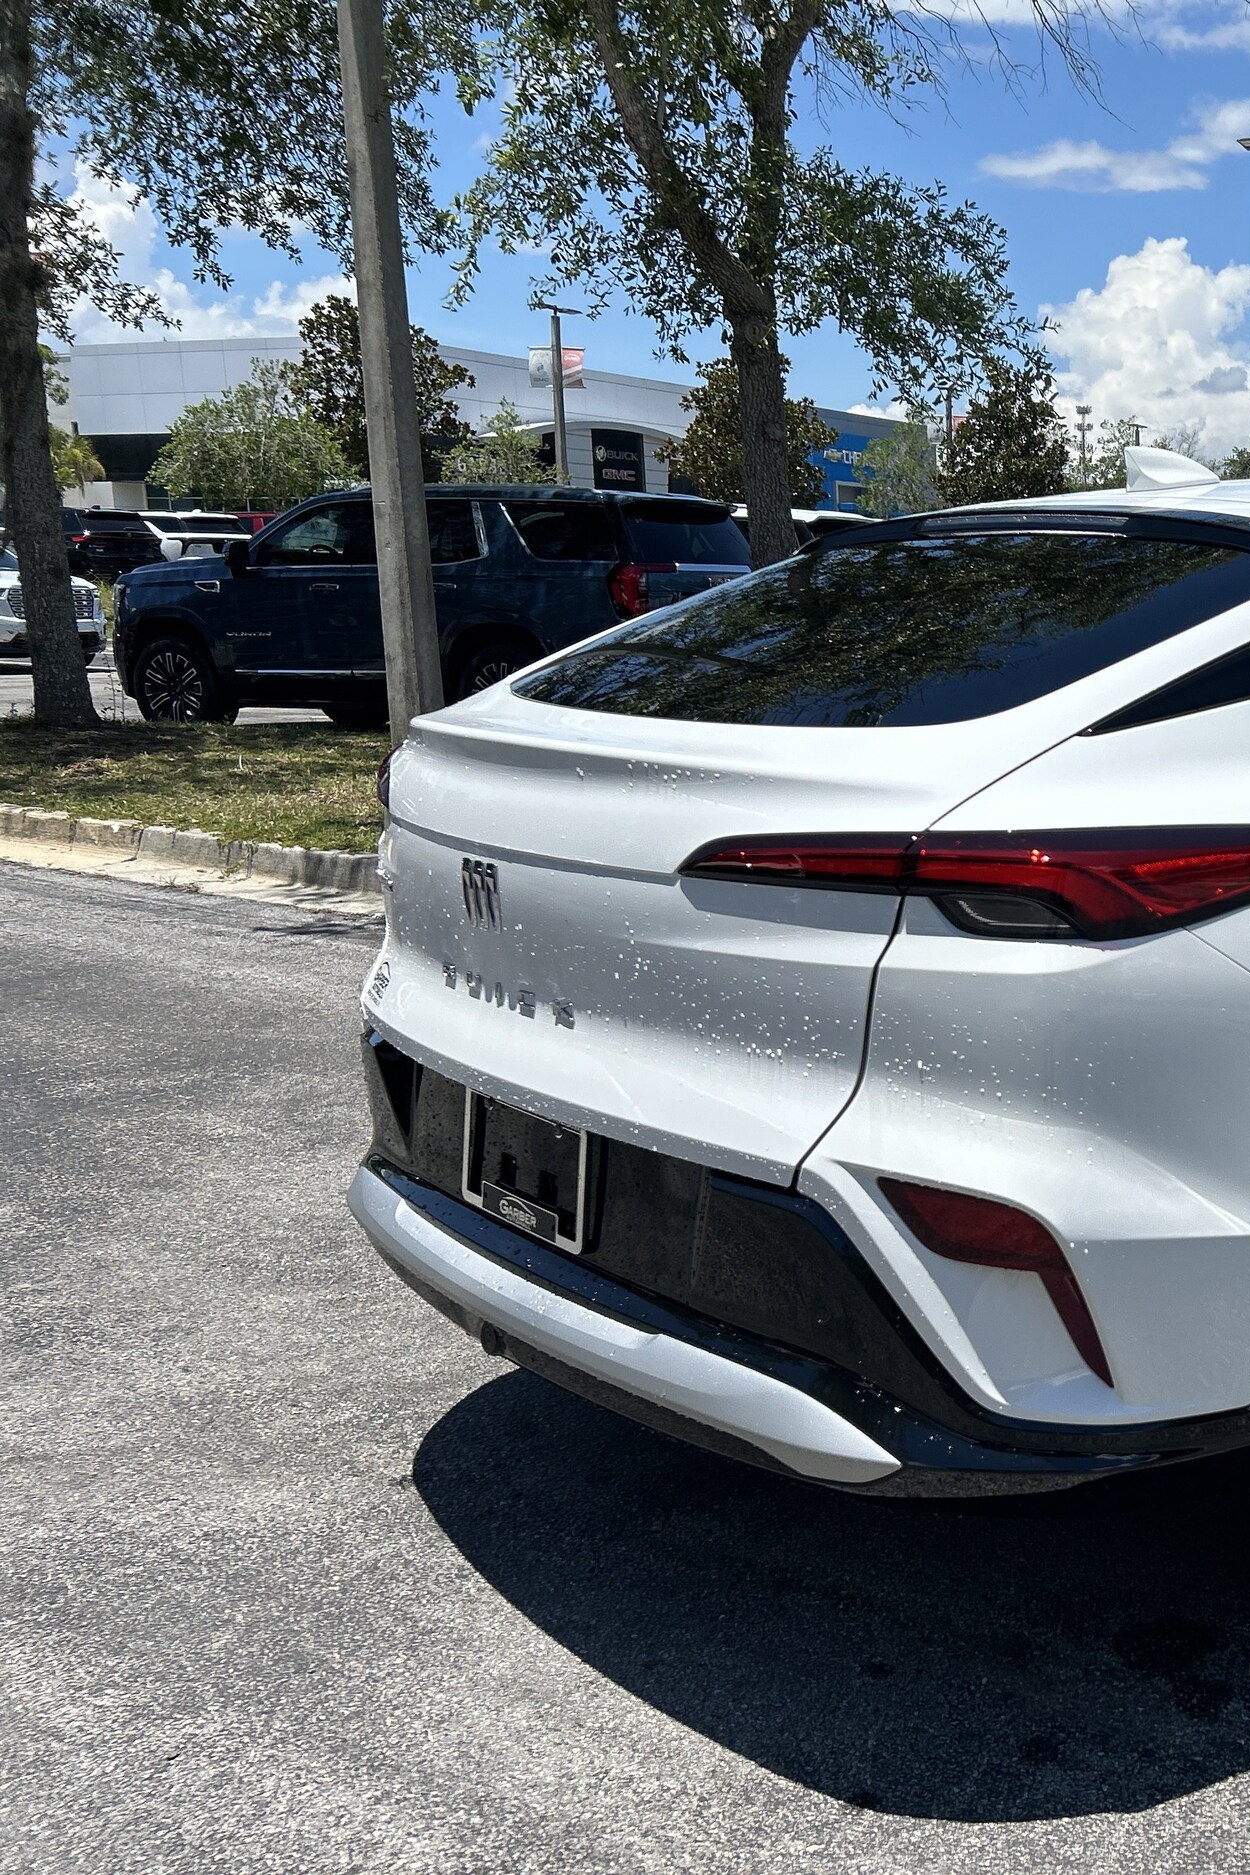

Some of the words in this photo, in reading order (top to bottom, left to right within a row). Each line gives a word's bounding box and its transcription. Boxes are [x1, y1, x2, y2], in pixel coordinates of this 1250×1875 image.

[606, 450, 639, 462] BUICK
[602, 468, 636, 481] GMC
[499, 1199, 537, 1228] GARBER
